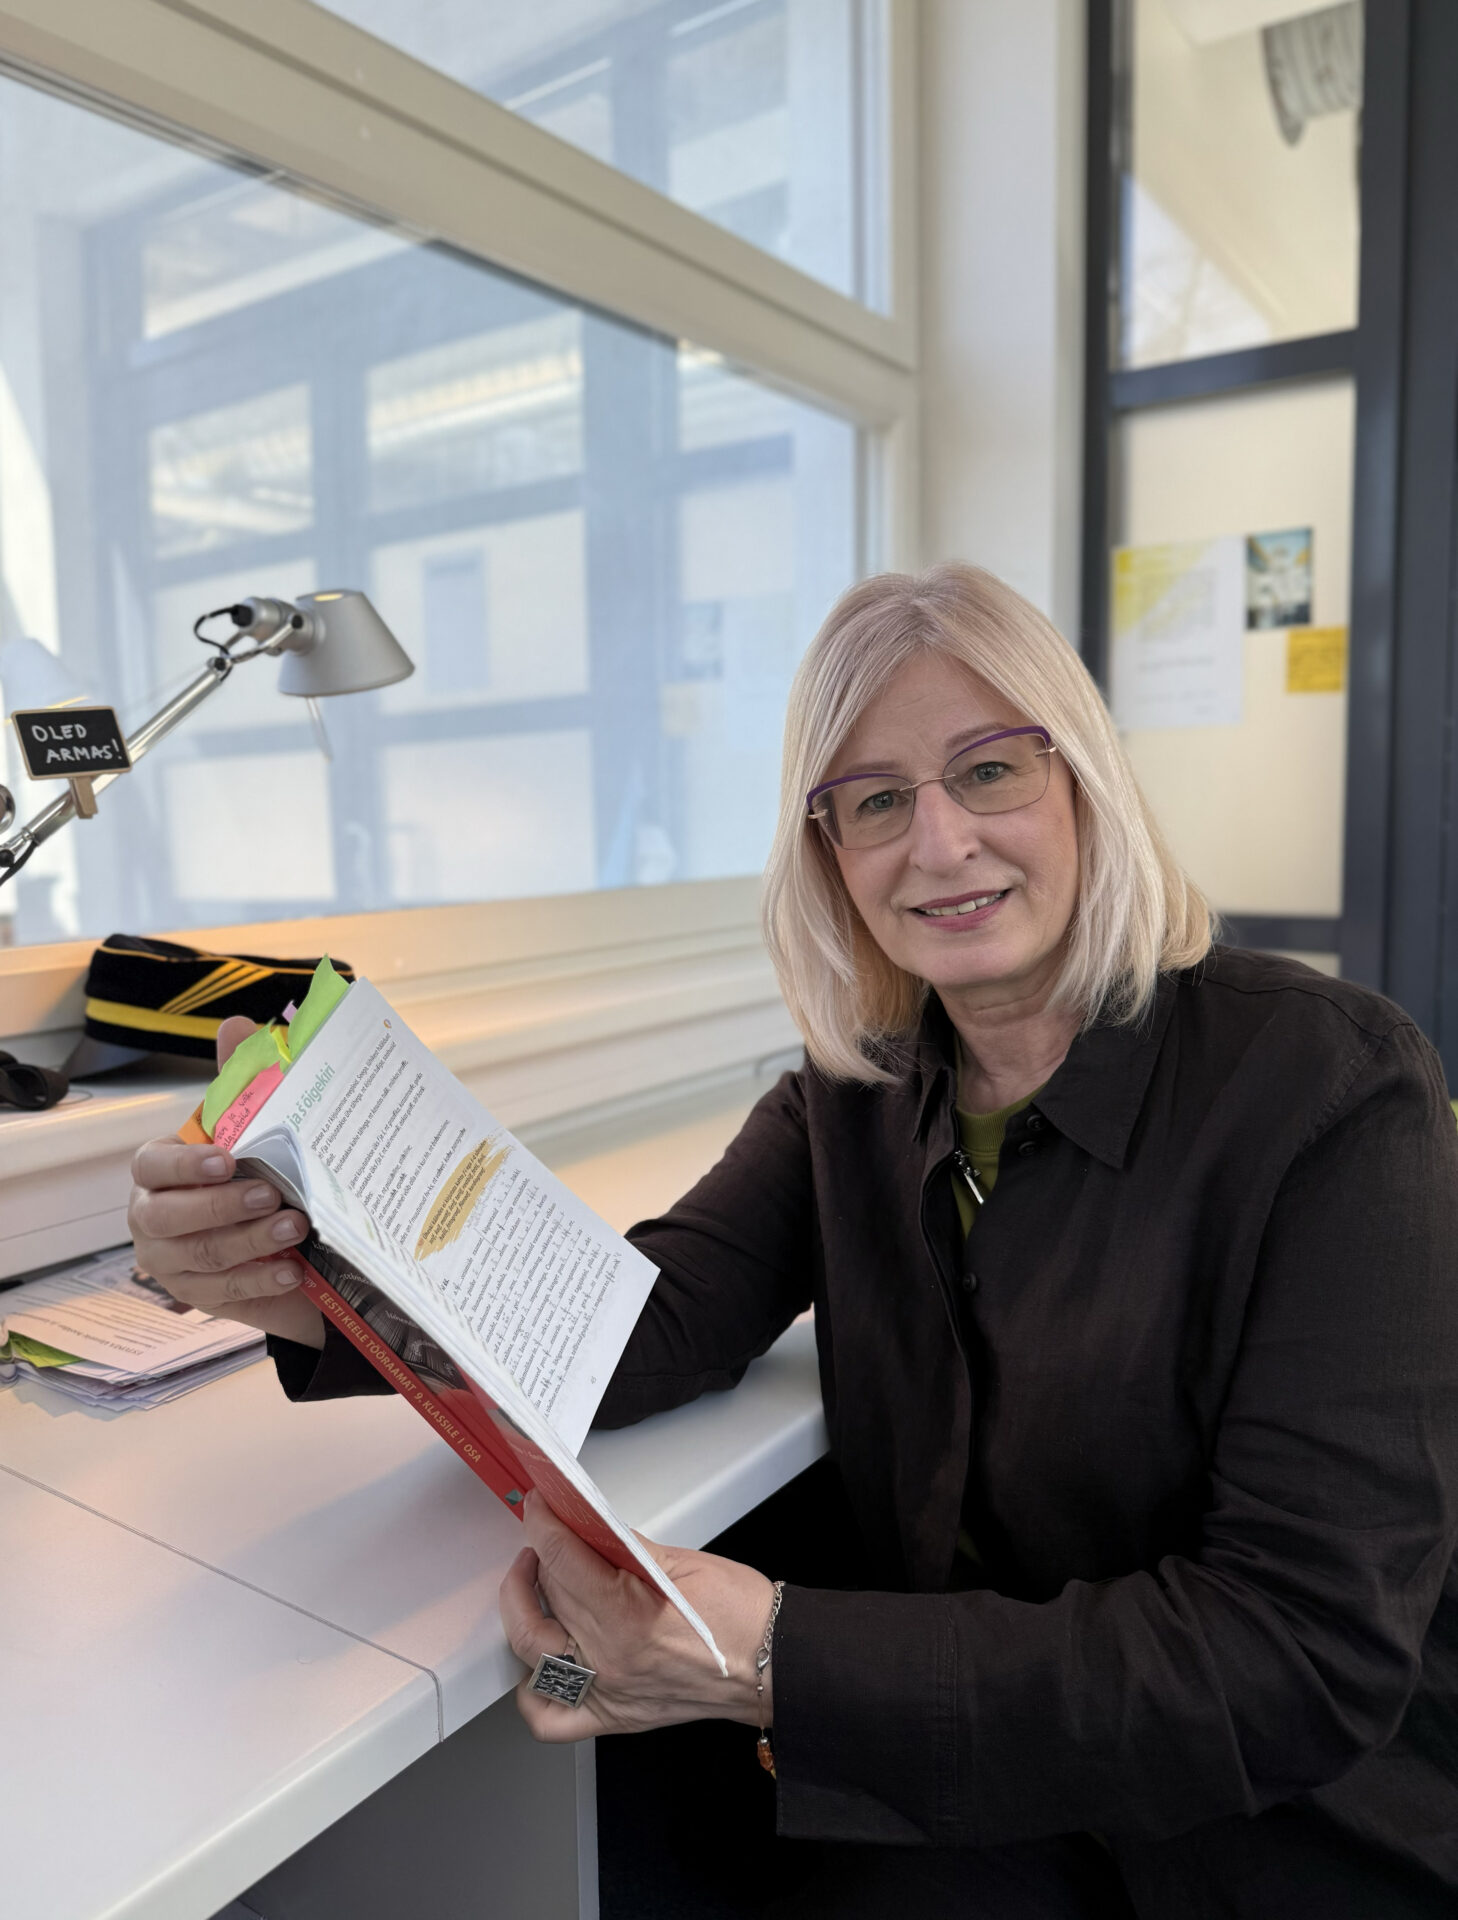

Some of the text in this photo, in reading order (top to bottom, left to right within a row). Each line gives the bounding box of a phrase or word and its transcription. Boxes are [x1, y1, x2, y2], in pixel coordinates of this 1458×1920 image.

[31, 723, 87, 742] OLED
[46, 738, 123, 764] ARMAS!
[286, 1115, 303, 1133] ja
[301, 1062, 336, 1110] õigekiri
[318, 1290, 345, 1318] EESTI
[340, 1313, 369, 1343] KEELE
[364, 1339, 417, 1393] TÖÖRAAMAT
[412, 1390, 426, 1403] 9.
[420, 1399, 460, 1439] KLASSILE
[461, 1442, 482, 1463] OSA
